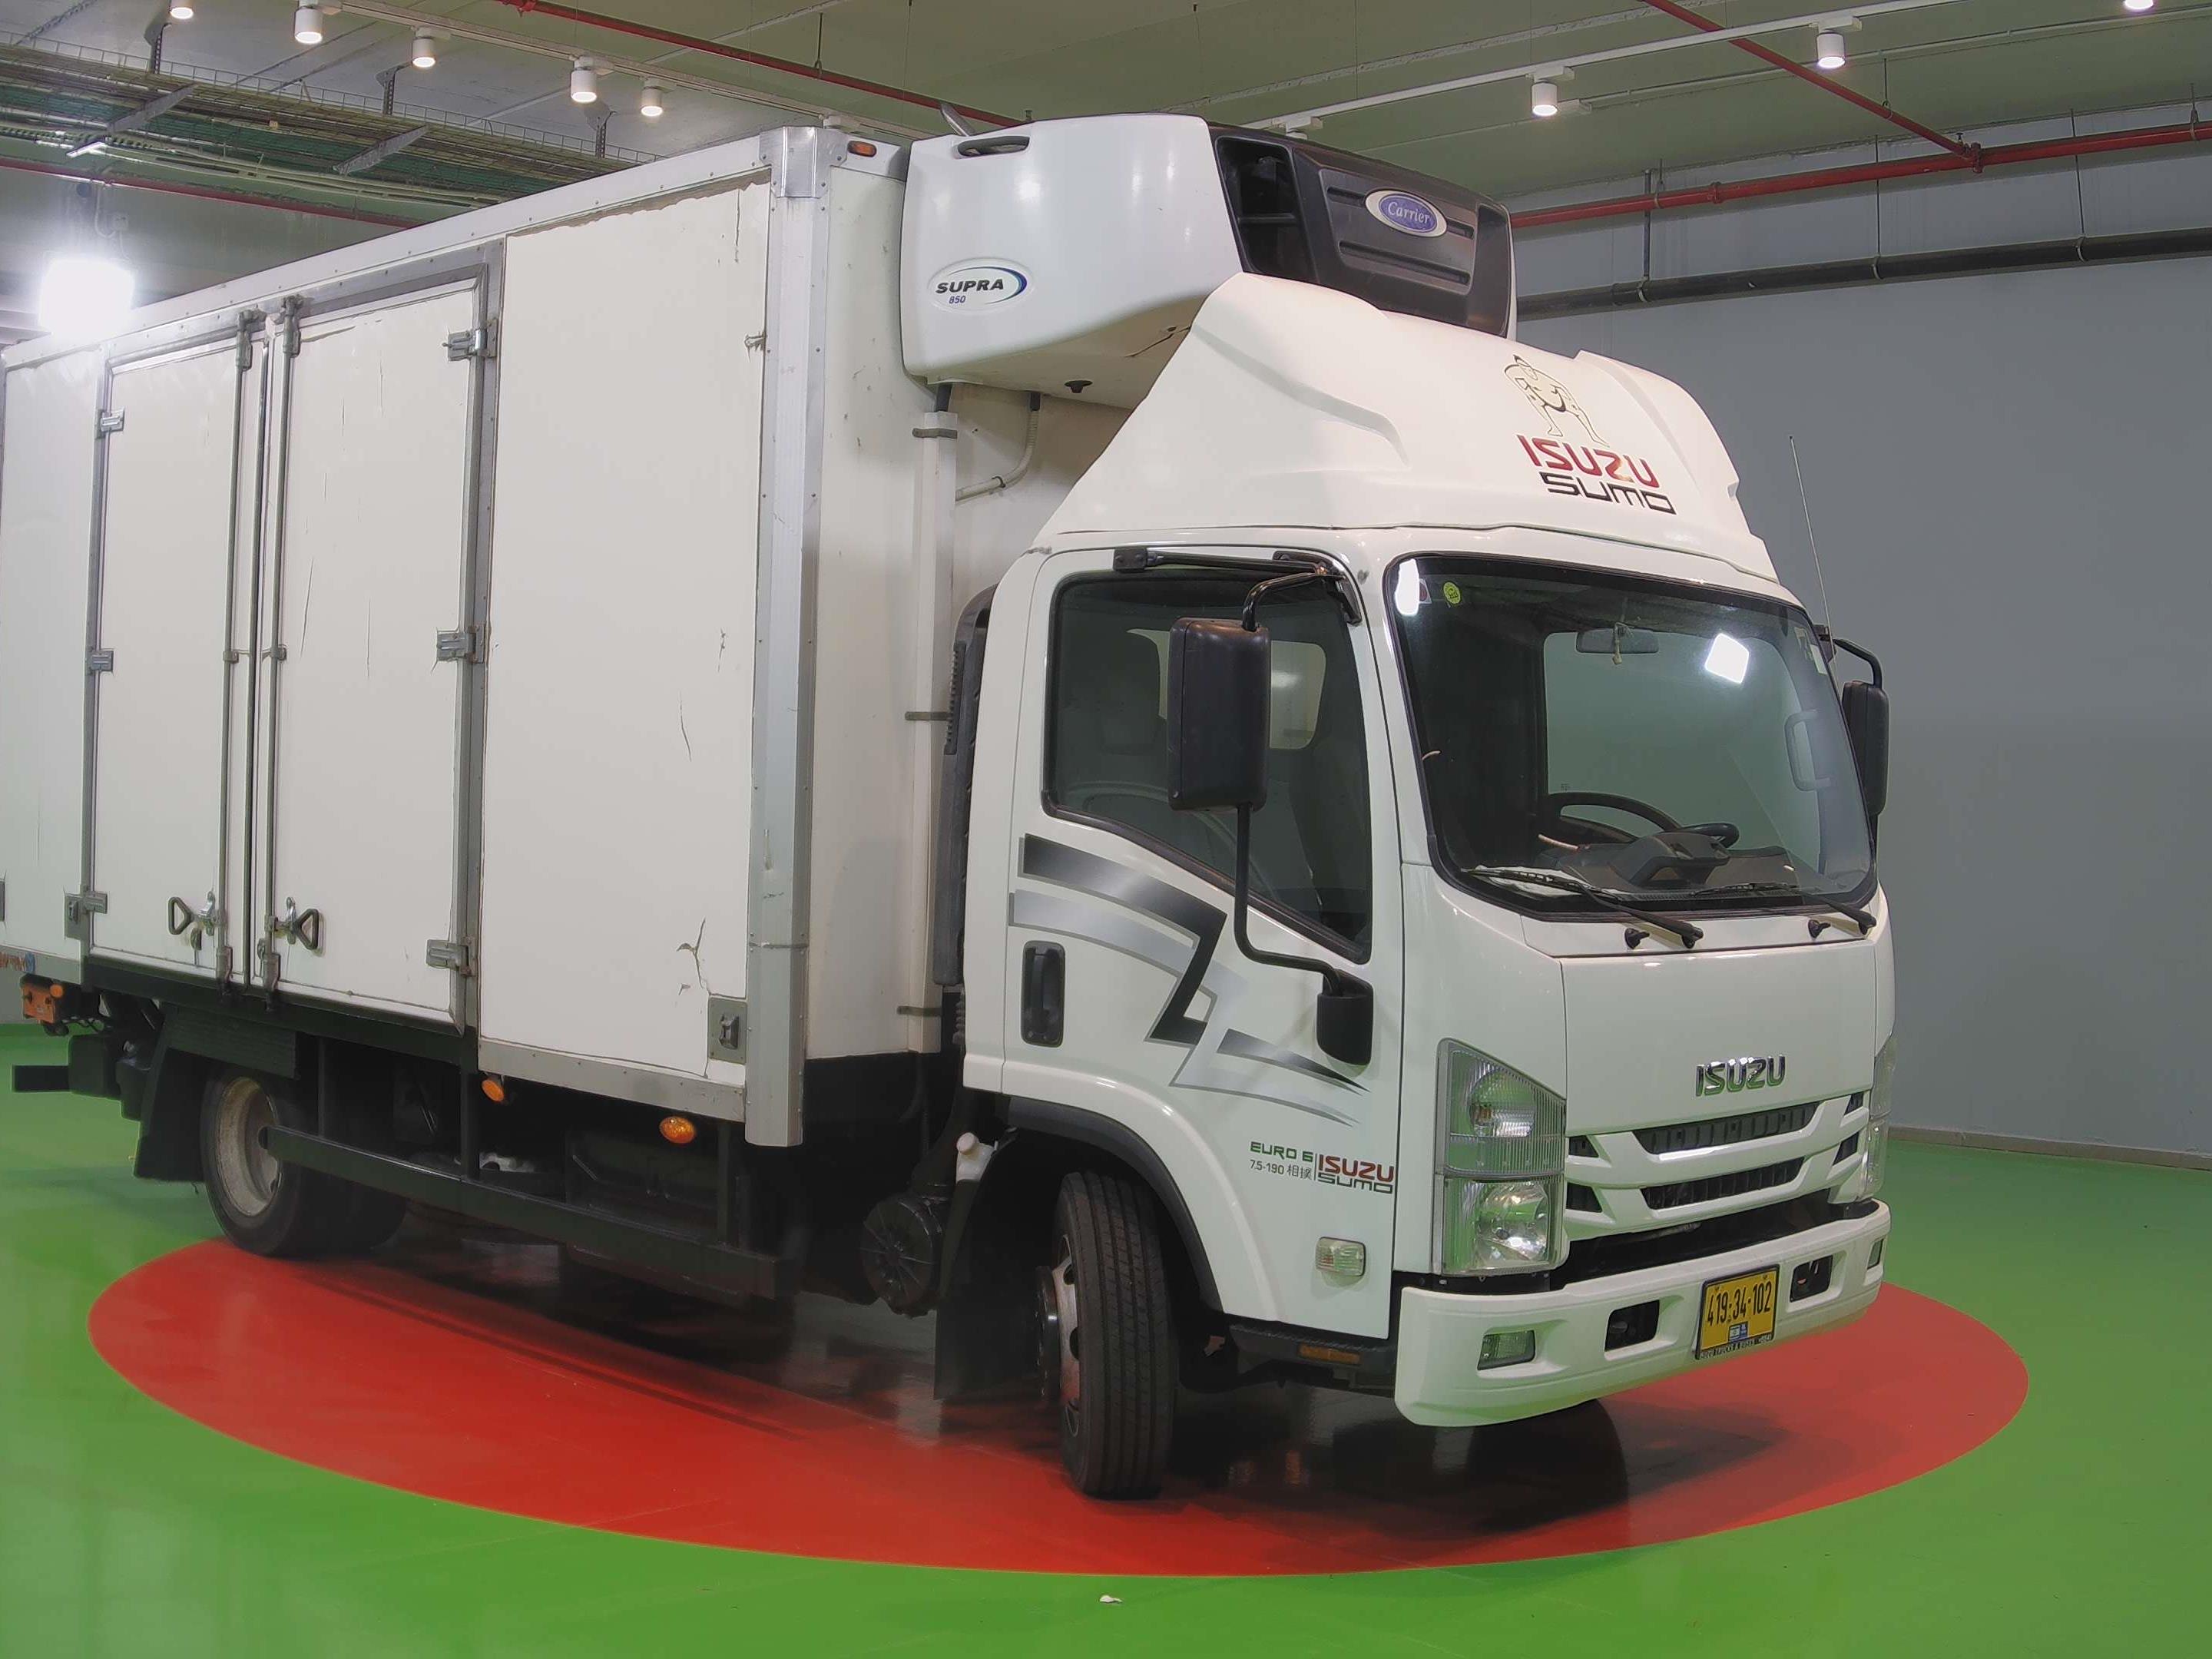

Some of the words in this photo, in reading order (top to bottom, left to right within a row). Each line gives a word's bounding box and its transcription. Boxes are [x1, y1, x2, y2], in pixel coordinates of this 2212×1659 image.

[1387, 201, 1429, 224] Carrier
[935, 278, 1004, 294] SUPRA
[949, 295, 966, 305] 850
[1516, 434, 1660, 488] ISUZU
[1538, 471, 1677, 515] SUMO
[1695, 1054, 1786, 1097] ISUZU
[1250, 1141, 1297, 1160] EURO
[1302, 1151, 1313, 1163] 6
[1318, 1154, 1394, 1183] ISUZU
[1317, 1172, 1393, 1195] SUMO
